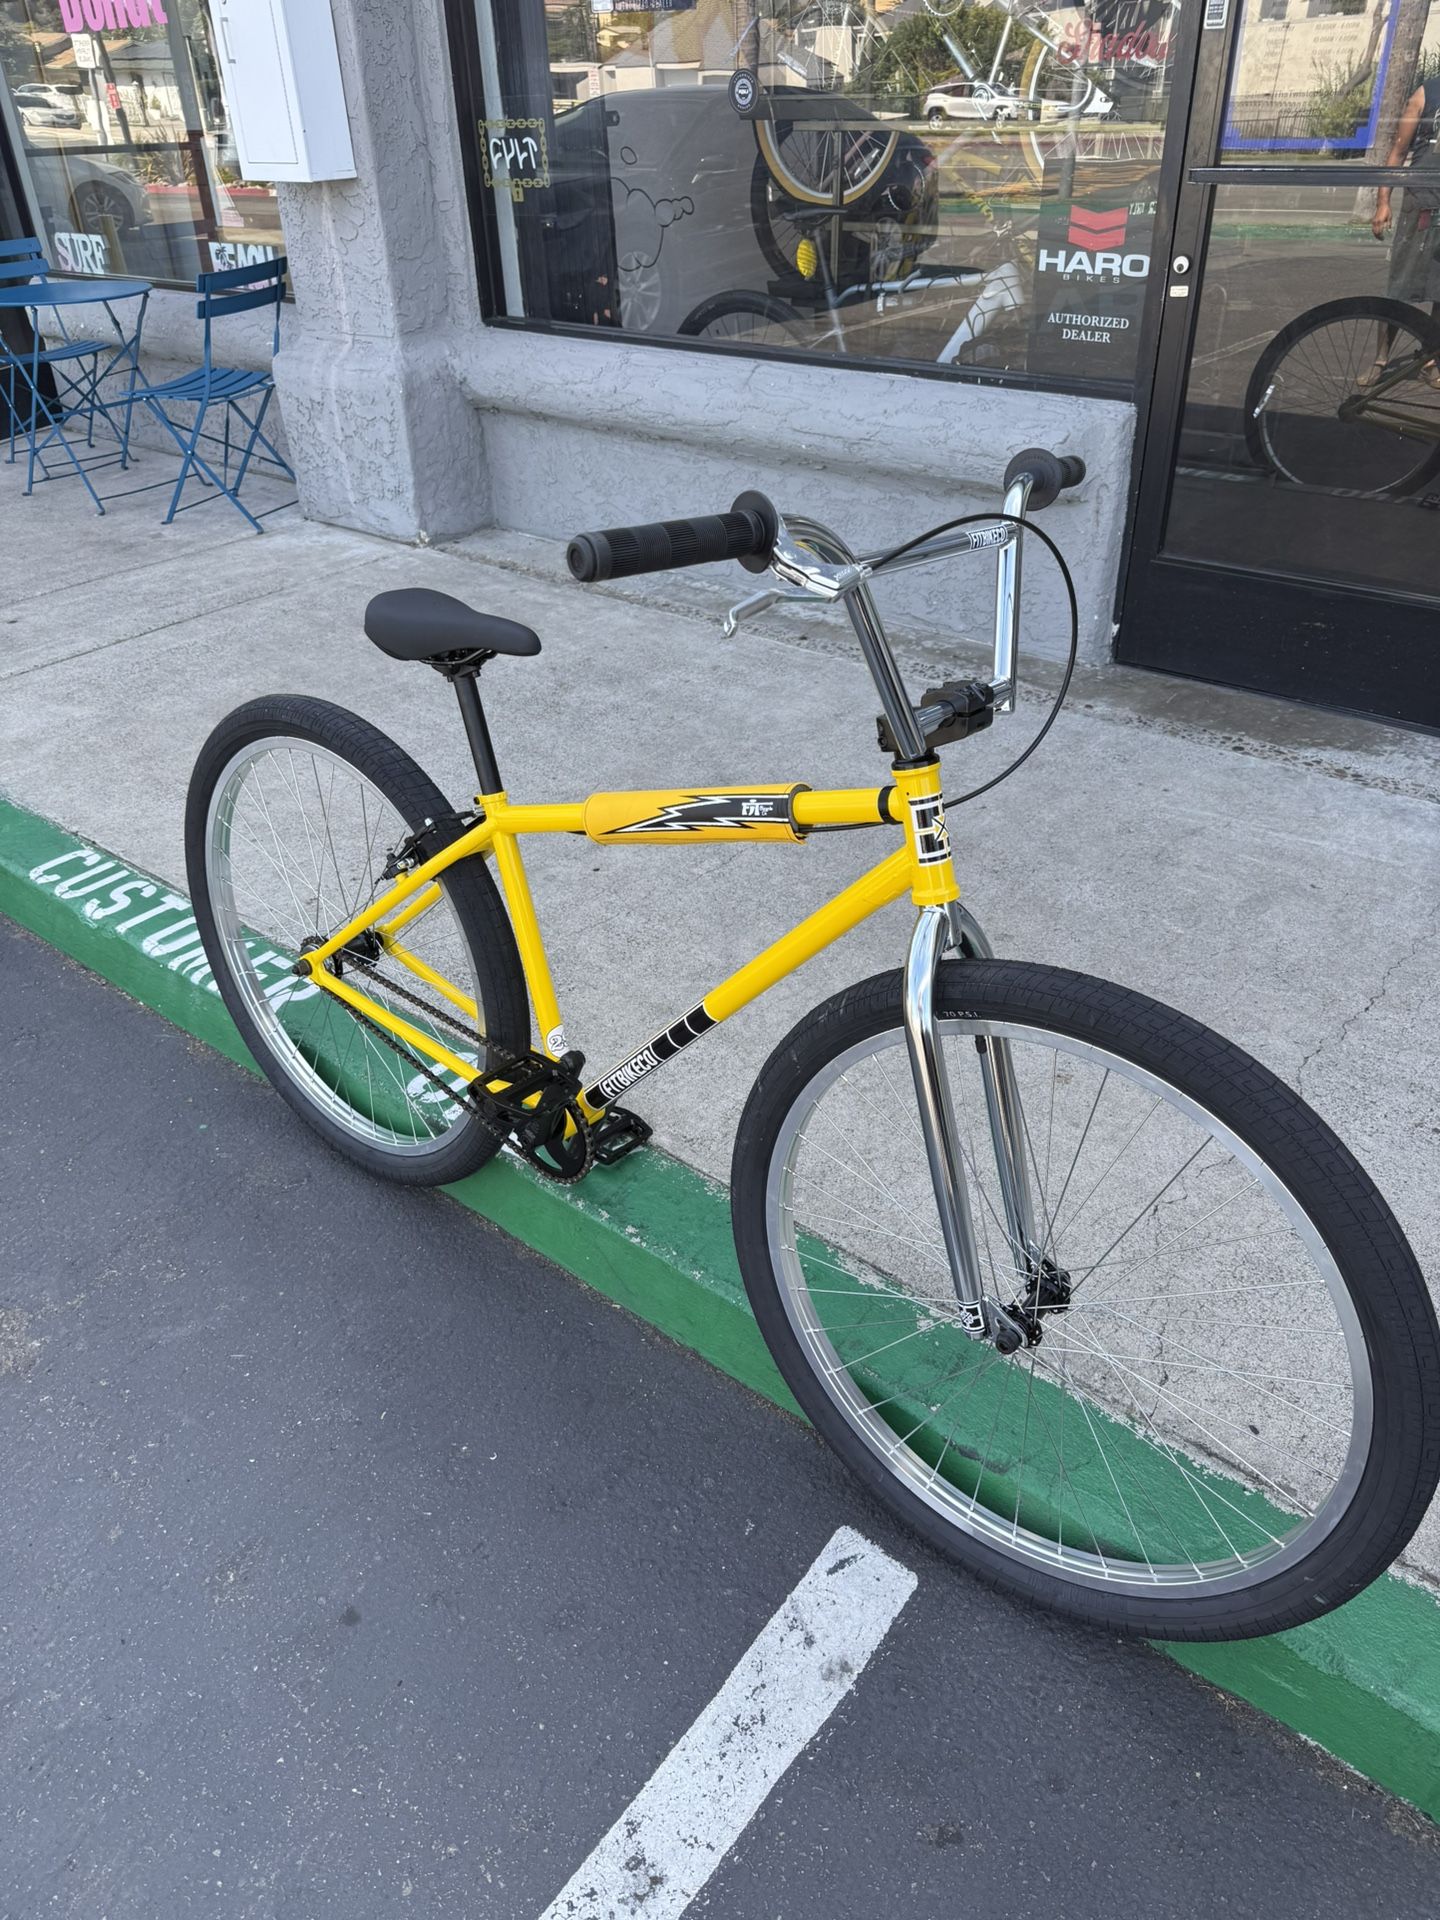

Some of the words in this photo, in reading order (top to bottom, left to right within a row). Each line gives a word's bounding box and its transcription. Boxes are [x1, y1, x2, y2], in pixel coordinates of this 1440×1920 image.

[489, 136, 538, 170] CULT
[54, 232, 106, 275] SURF
[1038, 249, 1150, 278] HARO
[1062, 274, 1120, 284] BIKES
[1047, 312, 1130, 330] AUTHORIZED
[1061, 328, 1111, 344] DEALER
[601, 1049, 659, 1097] FITBIKECO
